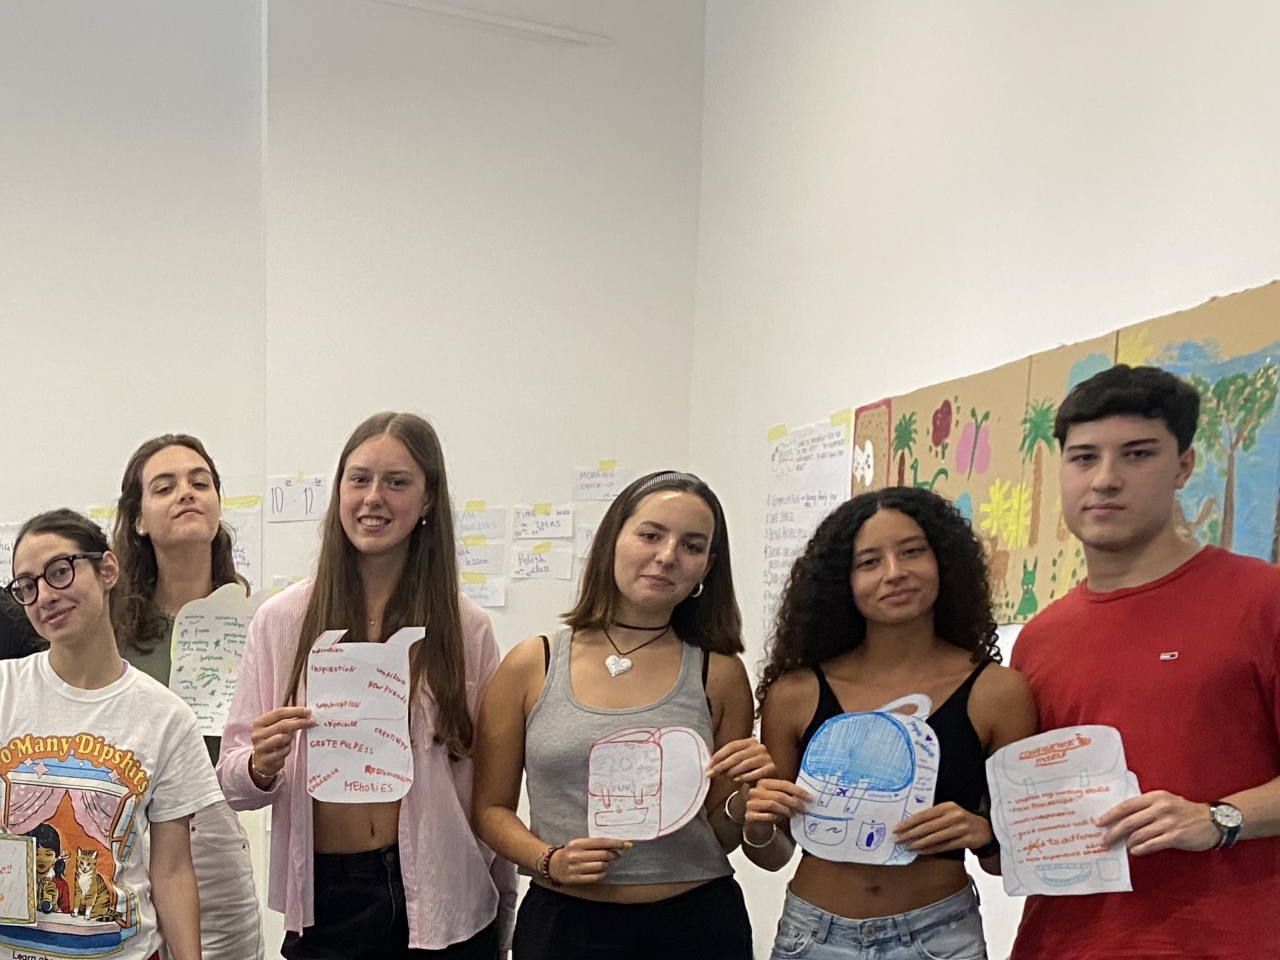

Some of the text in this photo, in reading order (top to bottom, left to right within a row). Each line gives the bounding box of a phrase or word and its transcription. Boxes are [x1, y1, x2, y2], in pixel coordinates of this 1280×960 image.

[466, 558, 488, 566] lesson
[518, 553, 546, 565] Polish
[10, 735, 73, 758] Many
[75, 734, 149, 792] Dipshits
